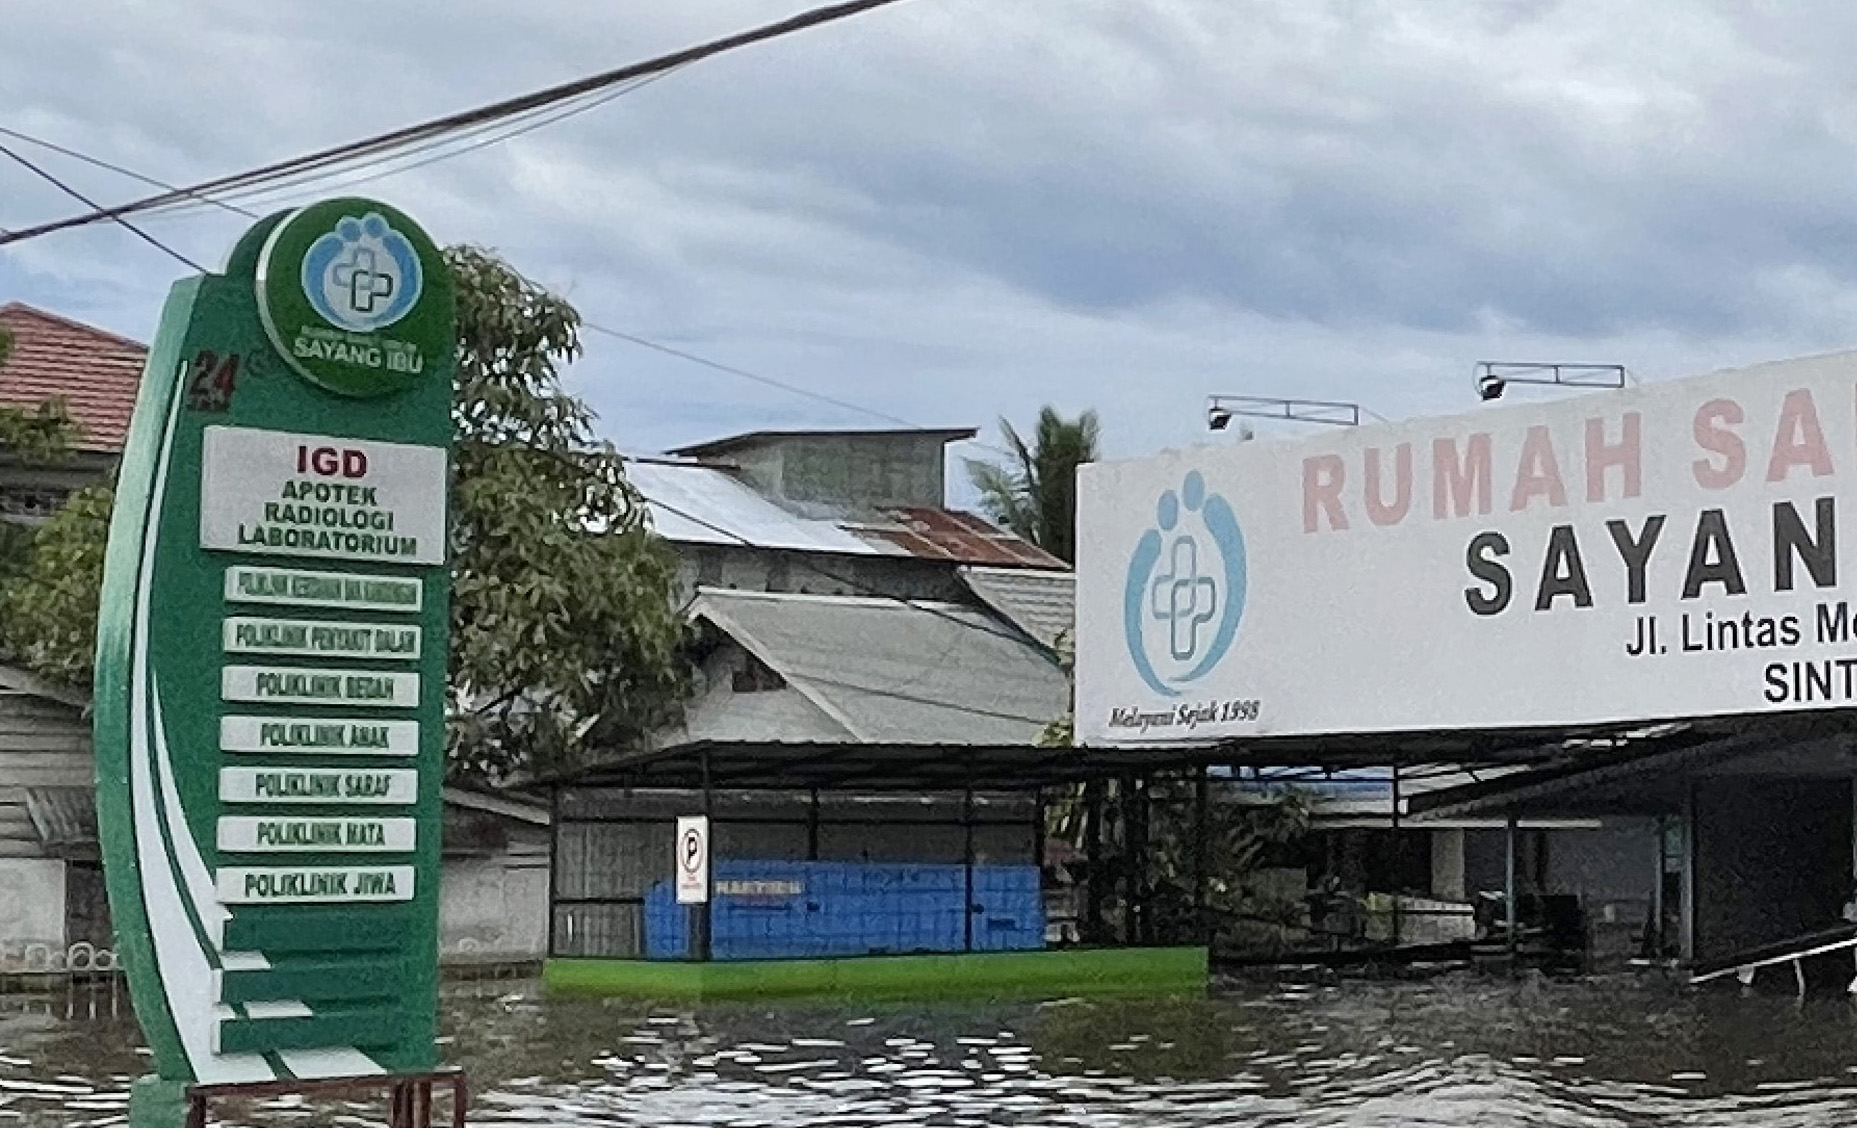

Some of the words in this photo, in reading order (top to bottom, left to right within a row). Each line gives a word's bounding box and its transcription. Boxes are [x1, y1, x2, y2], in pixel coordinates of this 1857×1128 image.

[292, 336, 382, 369] SAYANG
[385, 351, 424, 374] IBU
[296, 445, 368, 479] IGD
[1301, 411, 1643, 534] RUMAH
[281, 480, 378, 507] APOTEK
[263, 501, 394, 532] RADIOLOGI
[237, 522, 417, 556] LABORATORIUM
[1625, 615, 1667, 656] Jl.
[1681, 610, 1801, 653] Lintas
[1176, 699, 1219, 730] Sejak
[1220, 699, 1261, 723] 1998
[244, 872, 349, 898] POLIKLINIK
